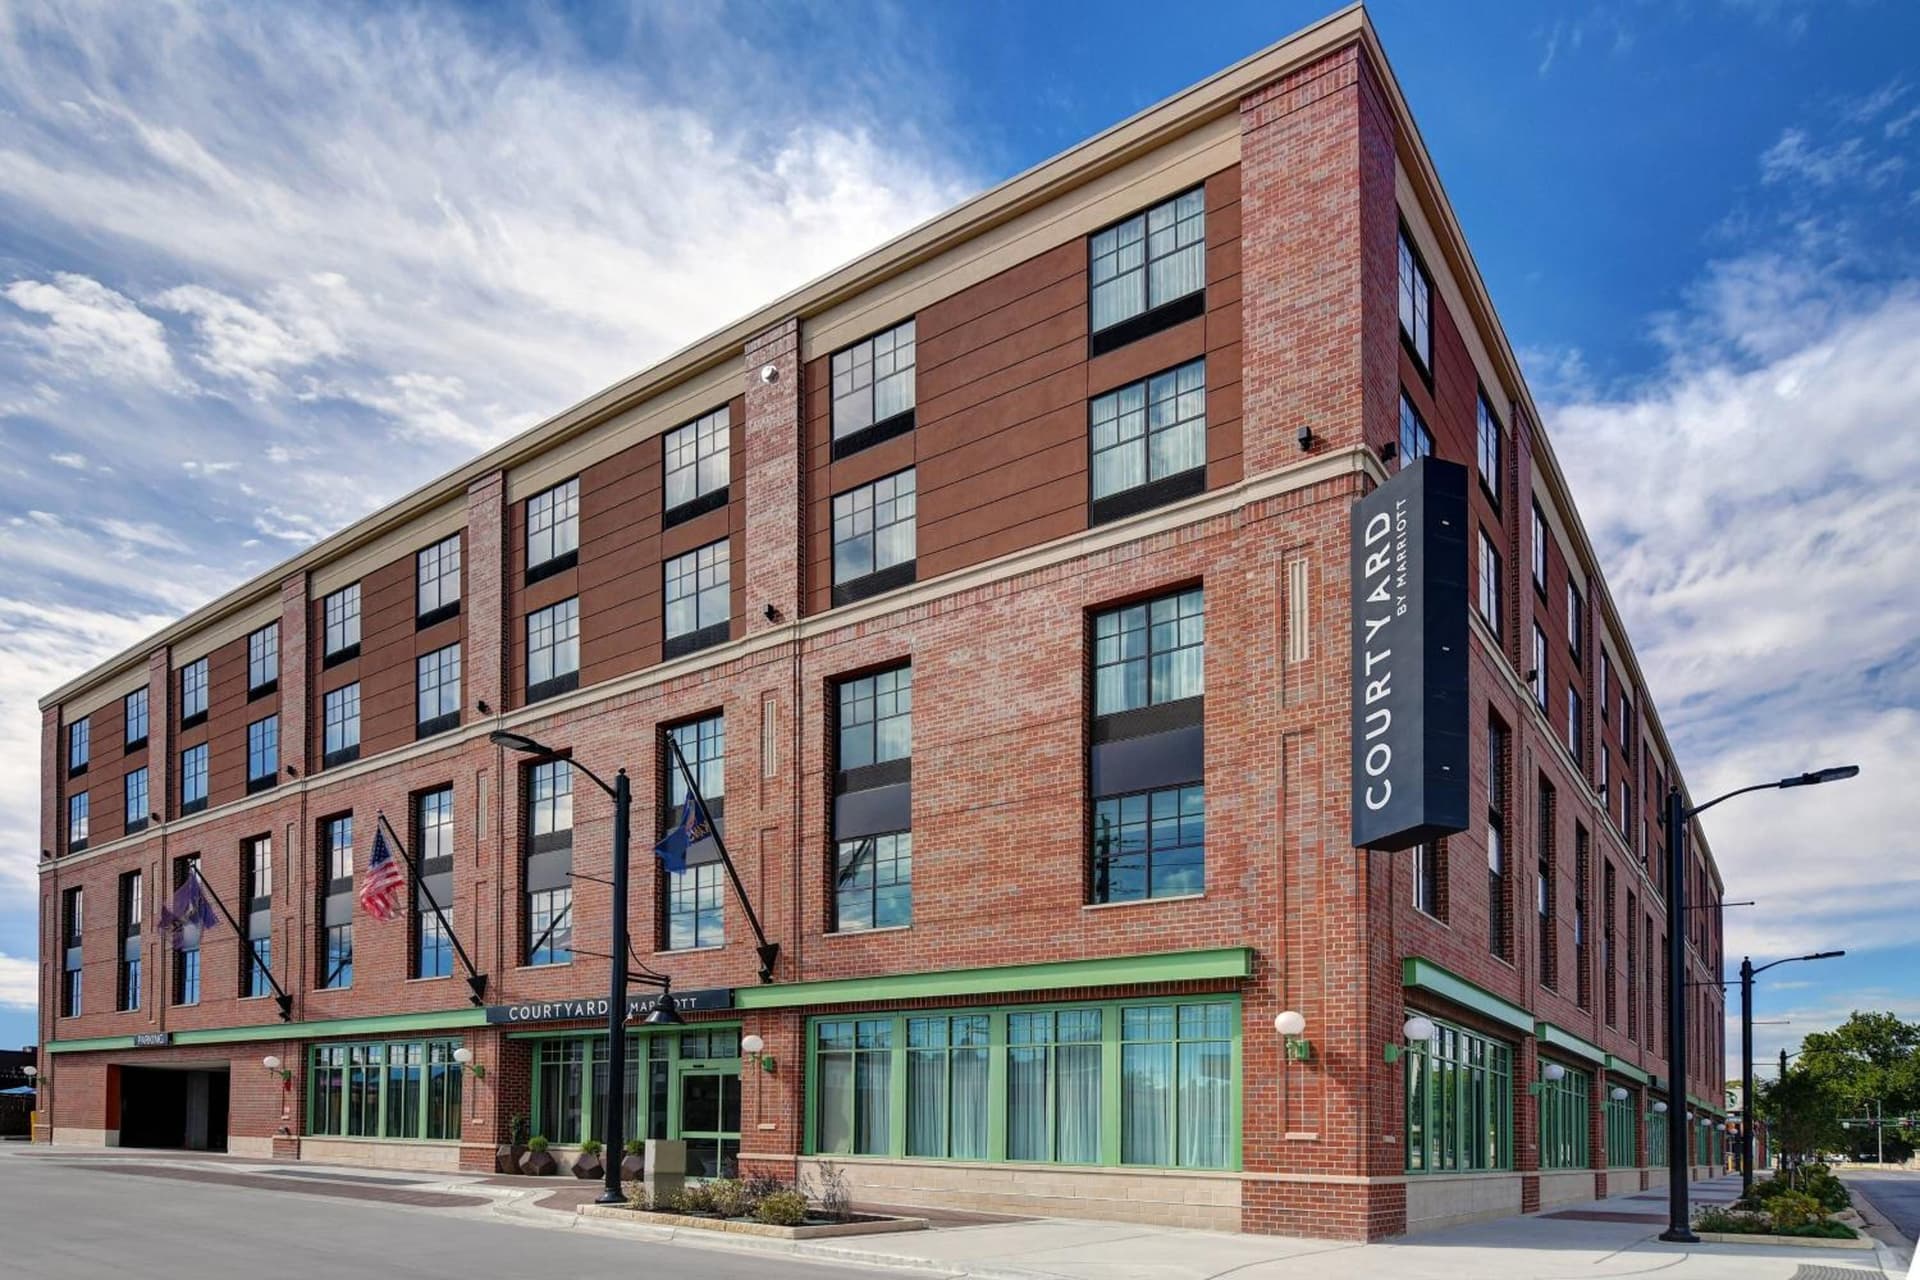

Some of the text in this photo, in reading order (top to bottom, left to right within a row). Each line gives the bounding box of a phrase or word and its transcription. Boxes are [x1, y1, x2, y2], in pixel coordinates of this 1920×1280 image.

[1396, 499, 1407, 616] BY MARRIOTT
[1365, 511, 1392, 810] COURTYARD
[509, 997, 697, 1021] COURTYARD MAROTT
